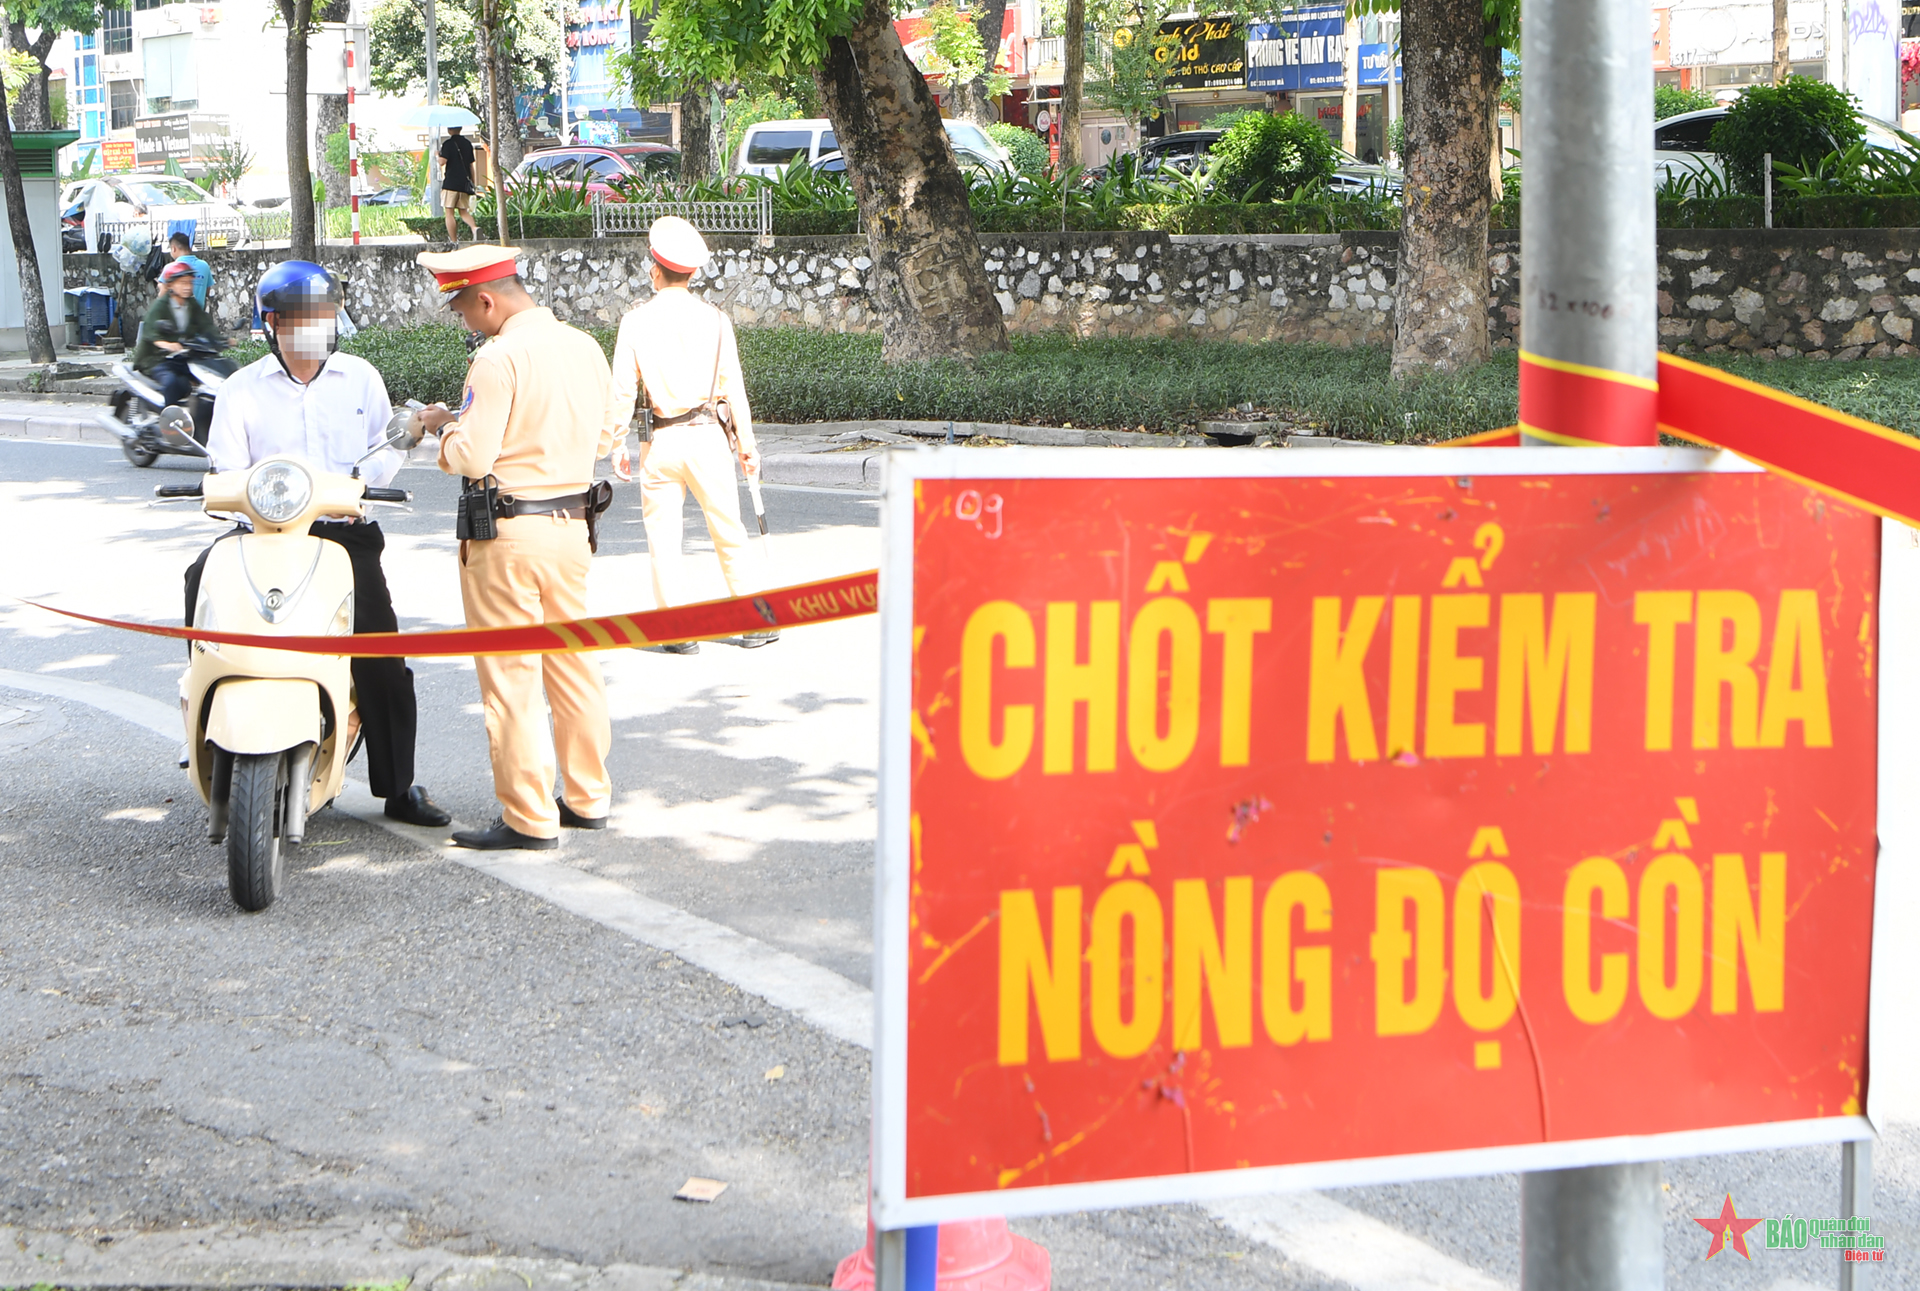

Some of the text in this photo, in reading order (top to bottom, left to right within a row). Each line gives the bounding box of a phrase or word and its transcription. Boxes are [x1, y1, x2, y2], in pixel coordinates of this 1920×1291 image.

[582, 28, 617, 46] LONG
[1184, 22, 1232, 43] Phát
[1248, 33, 1284, 68] PHÒNG
[1285, 32, 1299, 65] VÉ
[1300, 30, 1326, 65] MÁY
[1210, 63, 1227, 74] CAO
[137, 138, 155, 154] Made
[155, 136, 163, 152] in
[162, 135, 190, 152] Vietnam
[789, 582, 879, 620] KHU VỰ
[959, 521, 1834, 781] CHỐT KIỂM TRA
[997, 796, 1788, 1071] NỒNG ĐỘ CỒN
